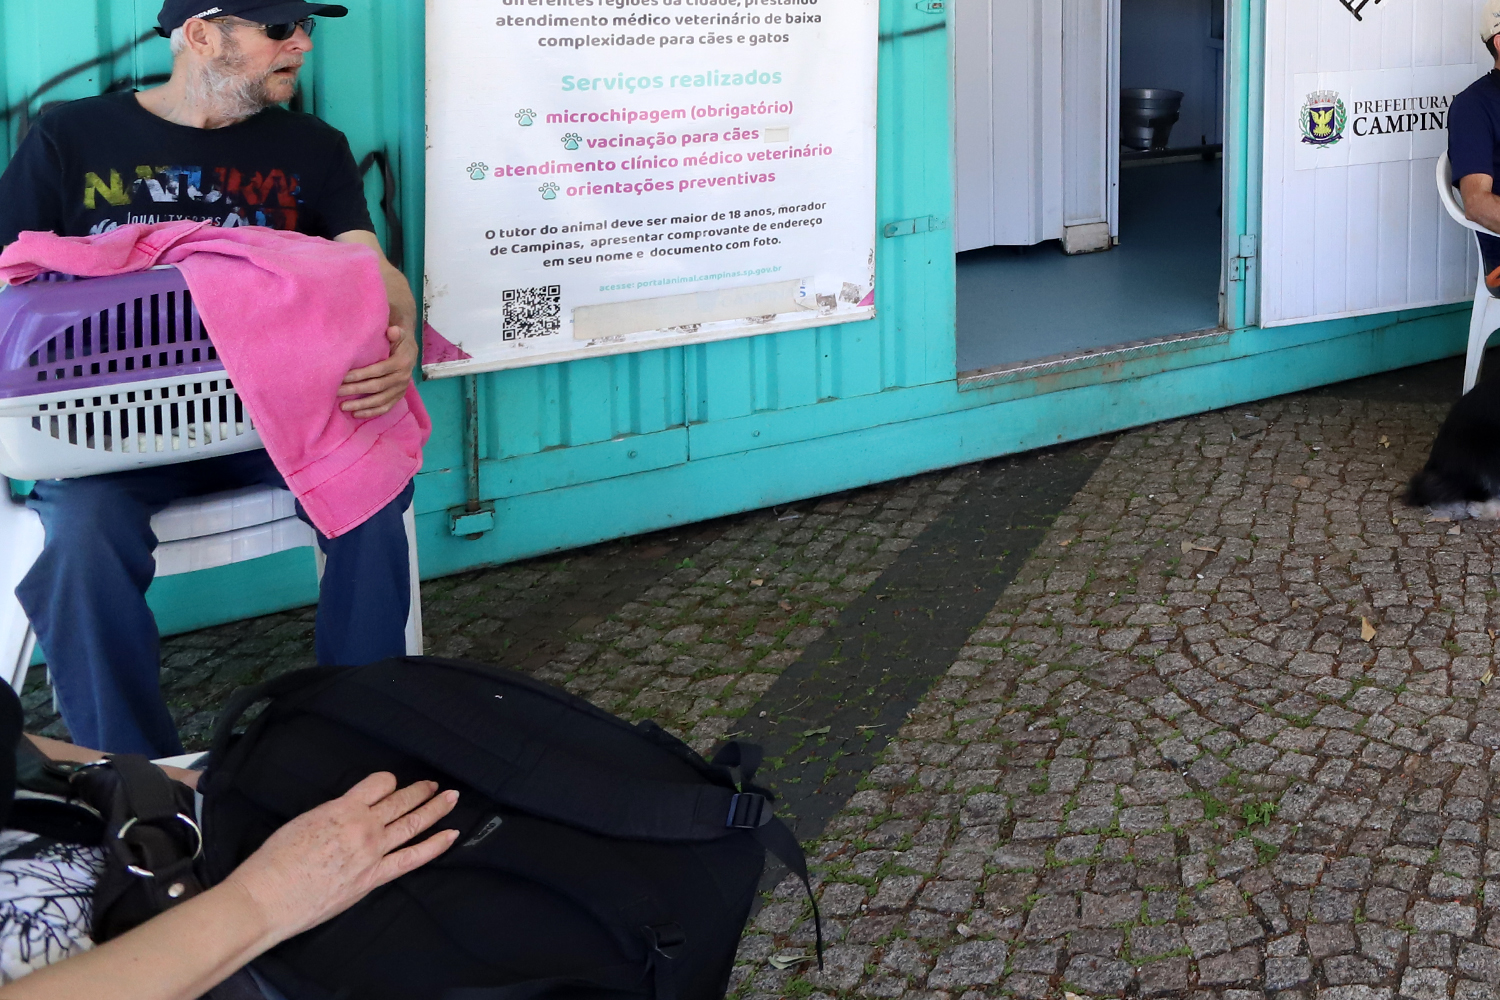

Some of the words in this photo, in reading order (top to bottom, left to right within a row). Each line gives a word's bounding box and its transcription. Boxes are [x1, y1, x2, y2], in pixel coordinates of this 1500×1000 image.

[496, 14, 608, 26] atendimento
[613, 13, 670, 25] médico
[675, 12, 760, 25] veterinário
[765, 13, 781, 24] de
[786, 12, 821, 24] baixa
[538, 34, 655, 49] complexidade
[660, 36, 694, 48] para
[699, 32, 733, 44] cães
[737, 35, 745, 43] e
[749, 33, 789, 46] gatos
[561, 72, 663, 94] Serviços
[670, 69, 782, 88] realizados
[547, 108, 686, 124] microchipagem
[691, 101, 793, 120] (obrigatório)
[1353, 96, 1449, 115] PREFEITURA
[1352, 111, 1448, 136] CAMPIN
[587, 132, 677, 149] vacinação
[682, 133, 718, 147] para
[723, 127, 759, 141] cães
[494, 160, 616, 177] atendimento
[621, 155, 678, 170] clínico
[683, 151, 742, 166] médico
[747, 144, 832, 161] veterinário
[567, 178, 674, 196] orientações
[679, 171, 775, 192] preventivas
[485, 230, 495, 239] O
[500, 228, 536, 238] tutor
[540, 225, 558, 234] do
[562, 220, 607, 233] animal
[611, 219, 643, 228] deve
[647, 218, 667, 226] ser
[671, 213, 708, 224] maior
[711, 212, 725, 221] de
[729, 210, 741, 219] 18
[744, 208, 775, 217] anos,
[778, 202, 826, 214] morador
[490, 246, 507, 255] de
[511, 240, 583, 253] Campinas,
[591, 233, 666, 249] apresentar
[668, 225, 750, 243] comprovante
[753, 223, 767, 231] de
[770, 218, 822, 233] endereço
[543, 259, 564, 267] em
[568, 256, 592, 265] seu
[596, 252, 633, 262] nome
[650, 244, 722, 256] documento
[726, 240, 750, 250] com
[754, 237, 781, 246] foto.
[599, 283, 634, 292] acesse:
[636, 266, 782, 290] portalanimal.campinas.sp.gov.br
